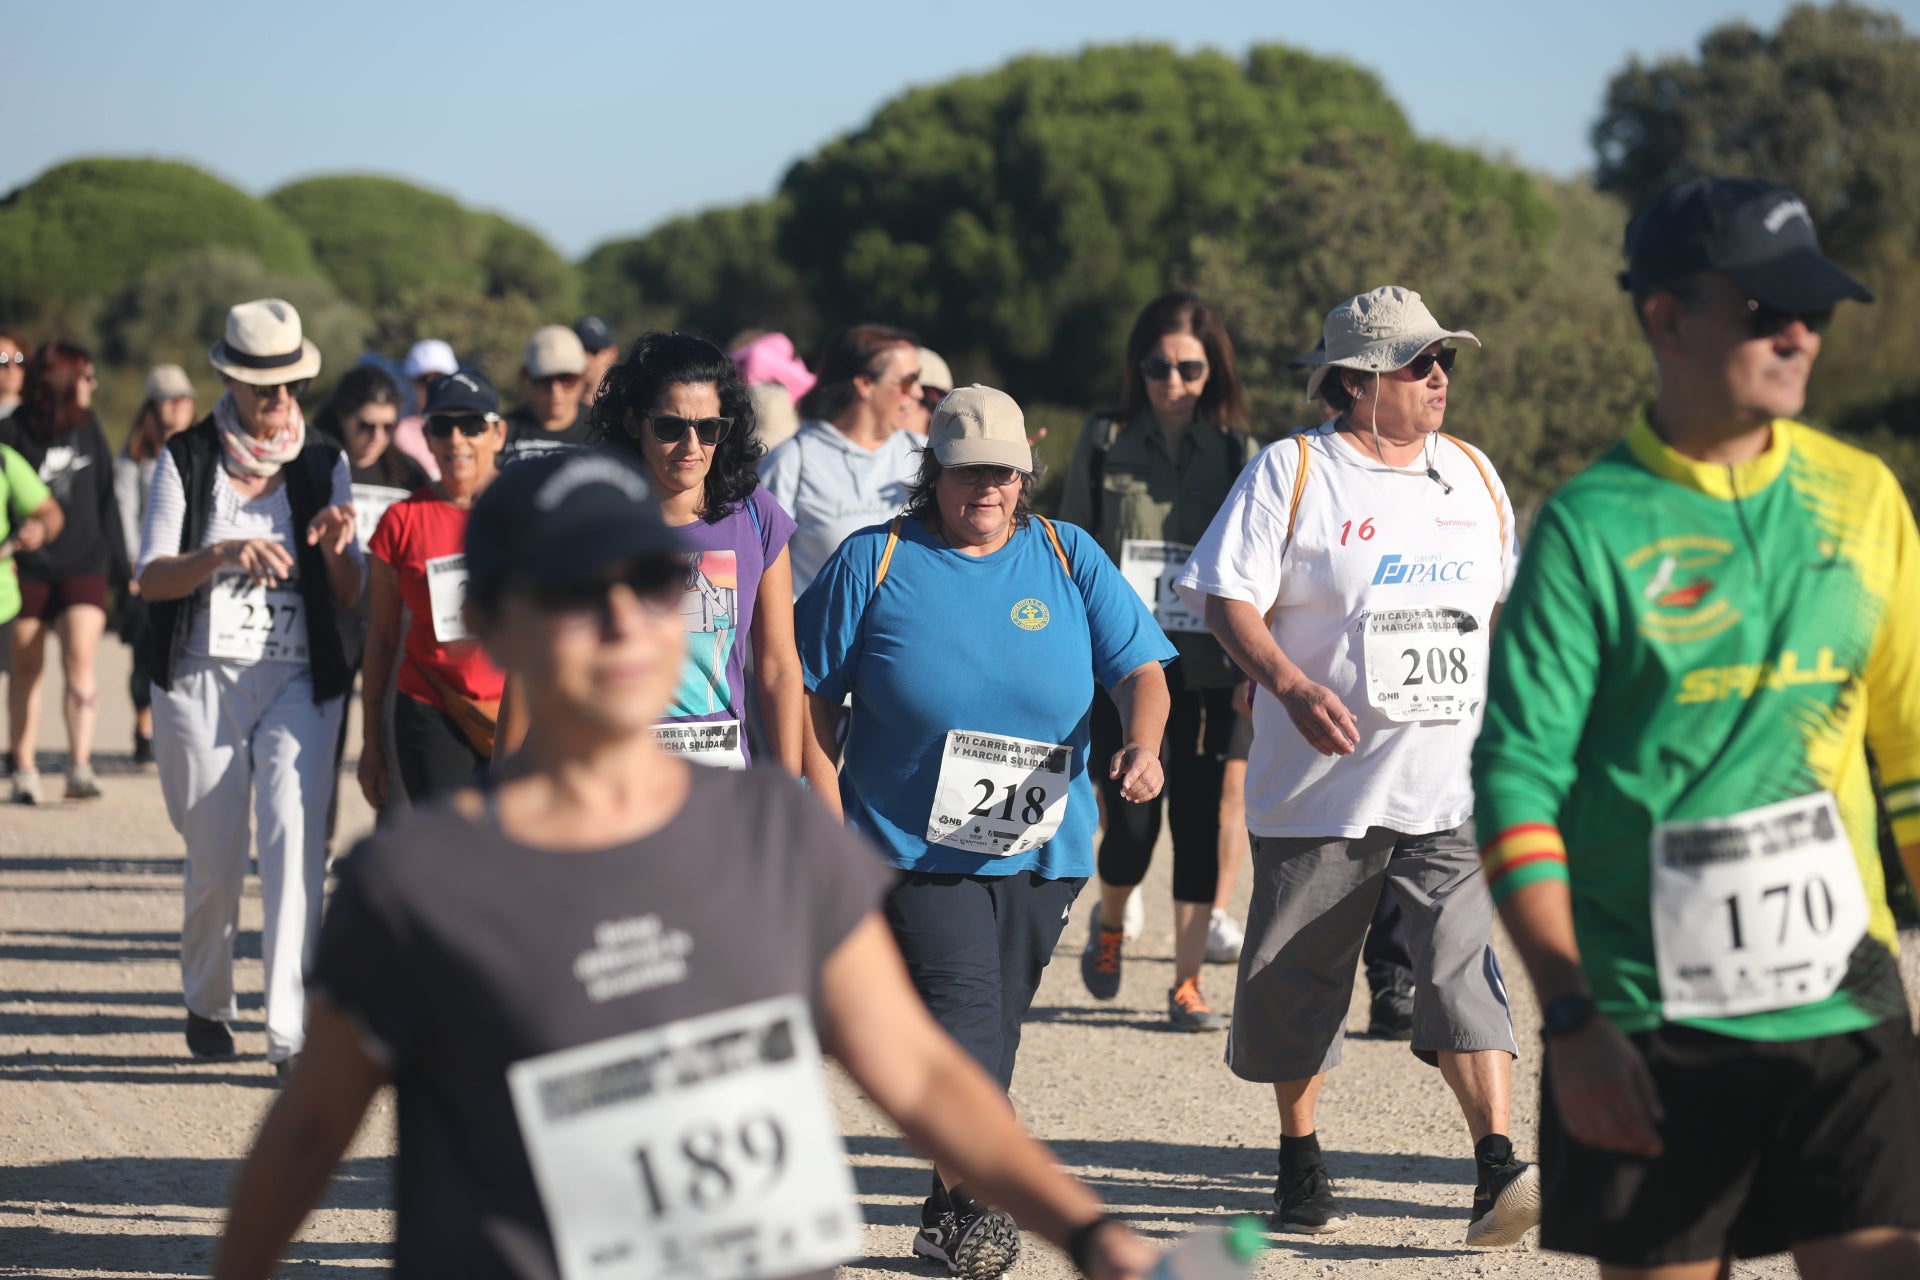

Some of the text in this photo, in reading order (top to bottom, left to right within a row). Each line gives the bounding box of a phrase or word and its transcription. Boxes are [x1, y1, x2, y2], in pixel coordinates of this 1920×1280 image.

[1340, 516, 1376, 546] 16
[1405, 561, 1474, 583] PACC
[239, 603, 297, 635] 227
[1373, 612, 1385, 621] VII
[1388, 610, 1434, 621] CARRERA
[1372, 625, 1378, 633] Y
[1381, 622, 1424, 633] MARCHA
[1400, 646, 1468, 687] 208
[1387, 691, 1400, 701] NB
[953, 746, 961, 755] Y
[961, 748, 1008, 764] MARCHA
[955, 735, 970, 746] VII
[972, 737, 1022, 754] CARRERA
[967, 778, 1047, 825] 218
[948, 817, 963, 826] NB
[1723, 873, 1834, 951] 170
[634, 1110, 791, 1219] 189
